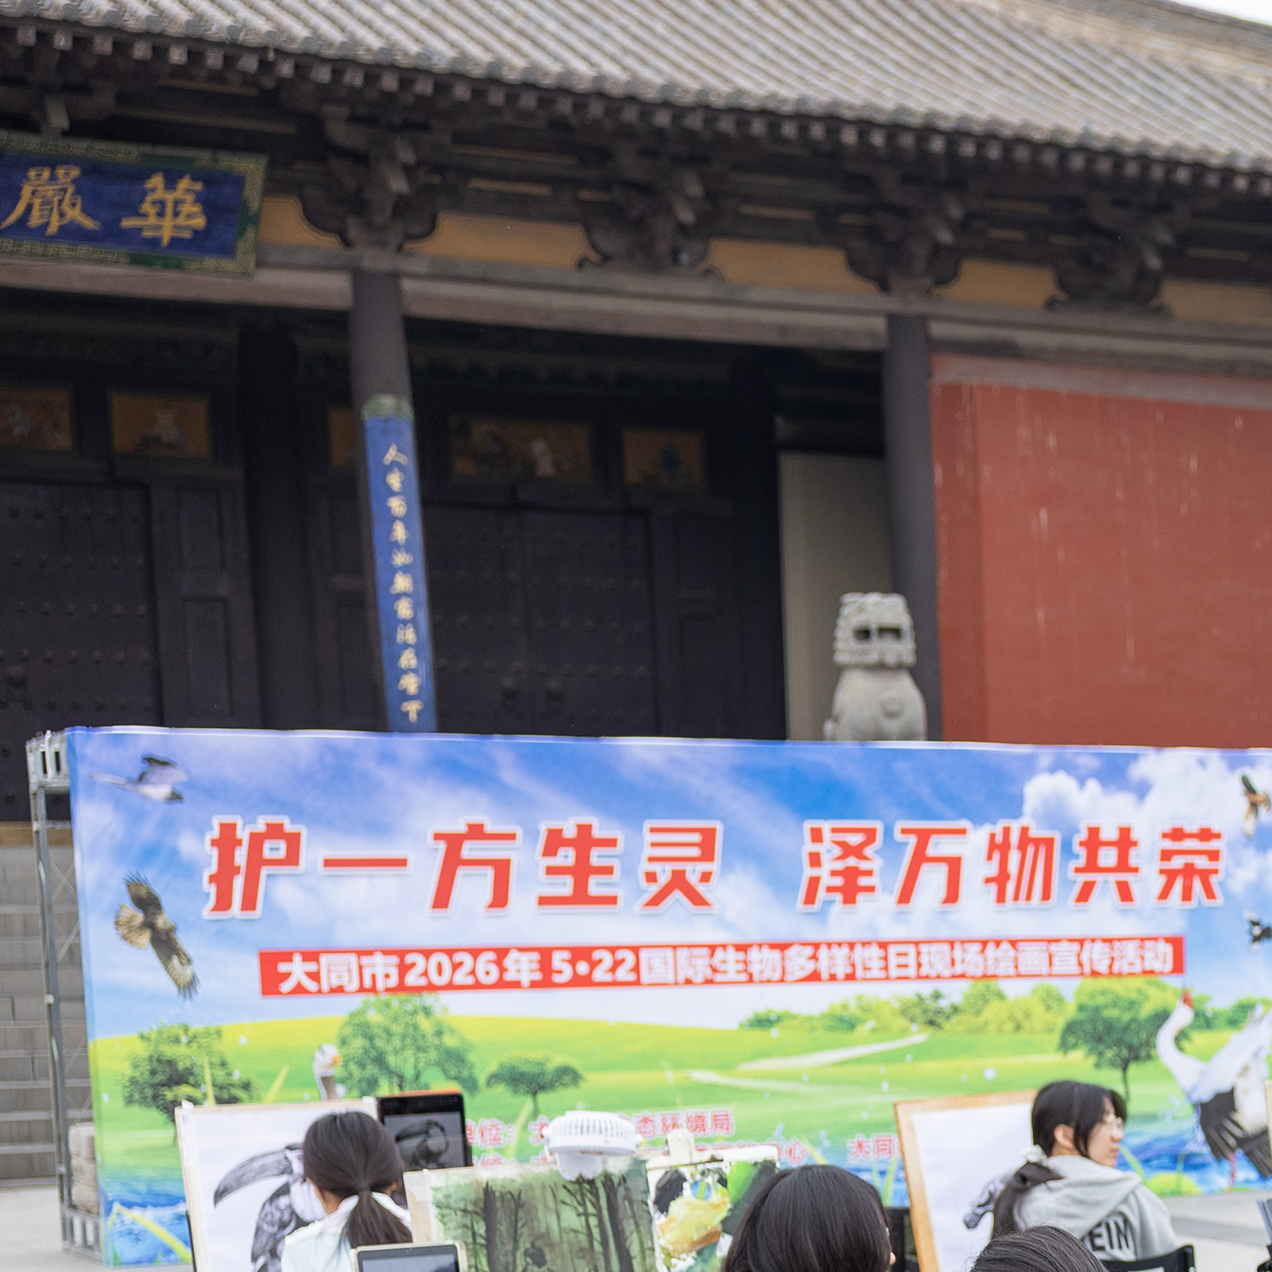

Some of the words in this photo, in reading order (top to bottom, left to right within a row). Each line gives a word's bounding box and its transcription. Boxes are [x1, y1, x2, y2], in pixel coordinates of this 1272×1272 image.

[206, 820, 720, 916] 护一方生灵
[800, 823, 1224, 908] 泽万物共荣
